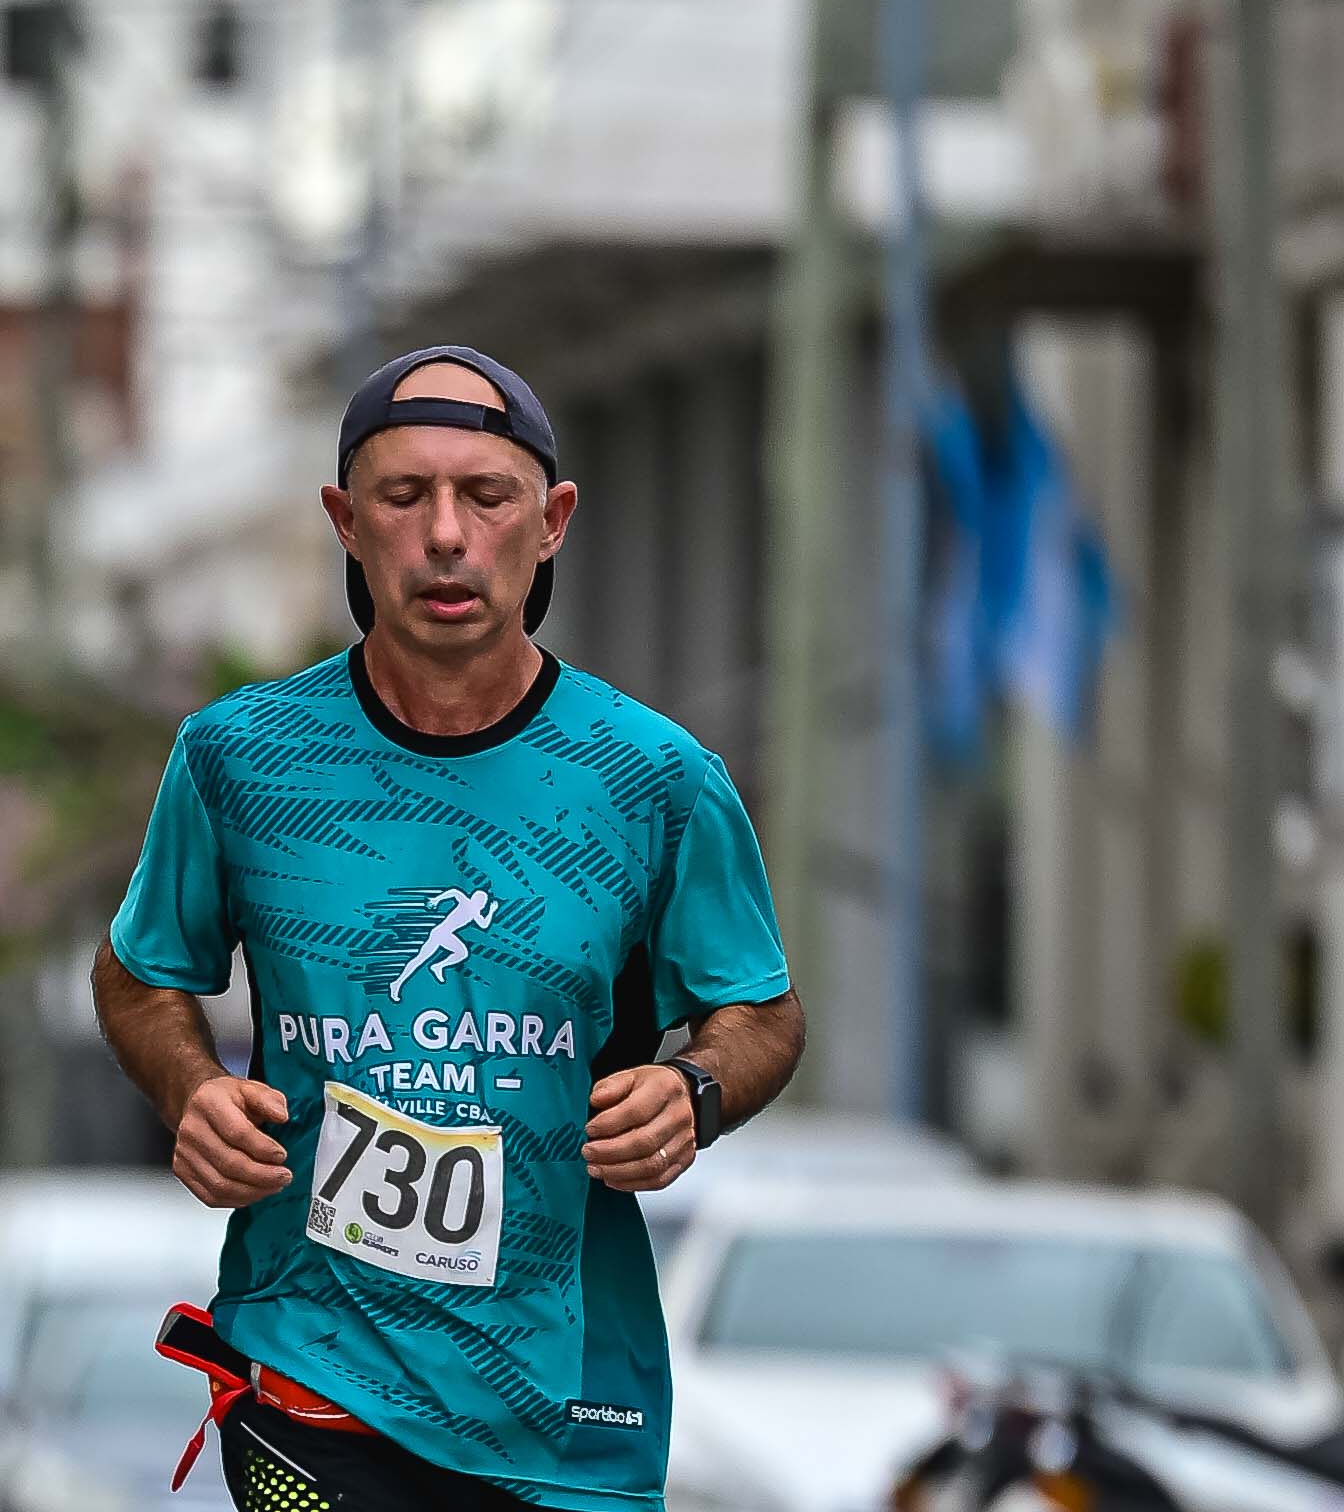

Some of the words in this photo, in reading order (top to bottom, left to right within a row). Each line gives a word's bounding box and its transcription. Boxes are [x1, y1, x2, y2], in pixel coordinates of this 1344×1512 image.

[278, 1013, 392, 1064] PURA
[413, 1009, 575, 1059] GARRA
[369, 1062, 475, 1093] TEAM
[396, 1099, 446, 1116] VILLE
[456, 1103, 494, 1124] CBA
[318, 1101, 485, 1245] 730
[415, 1252, 479, 1271] CARUSO
